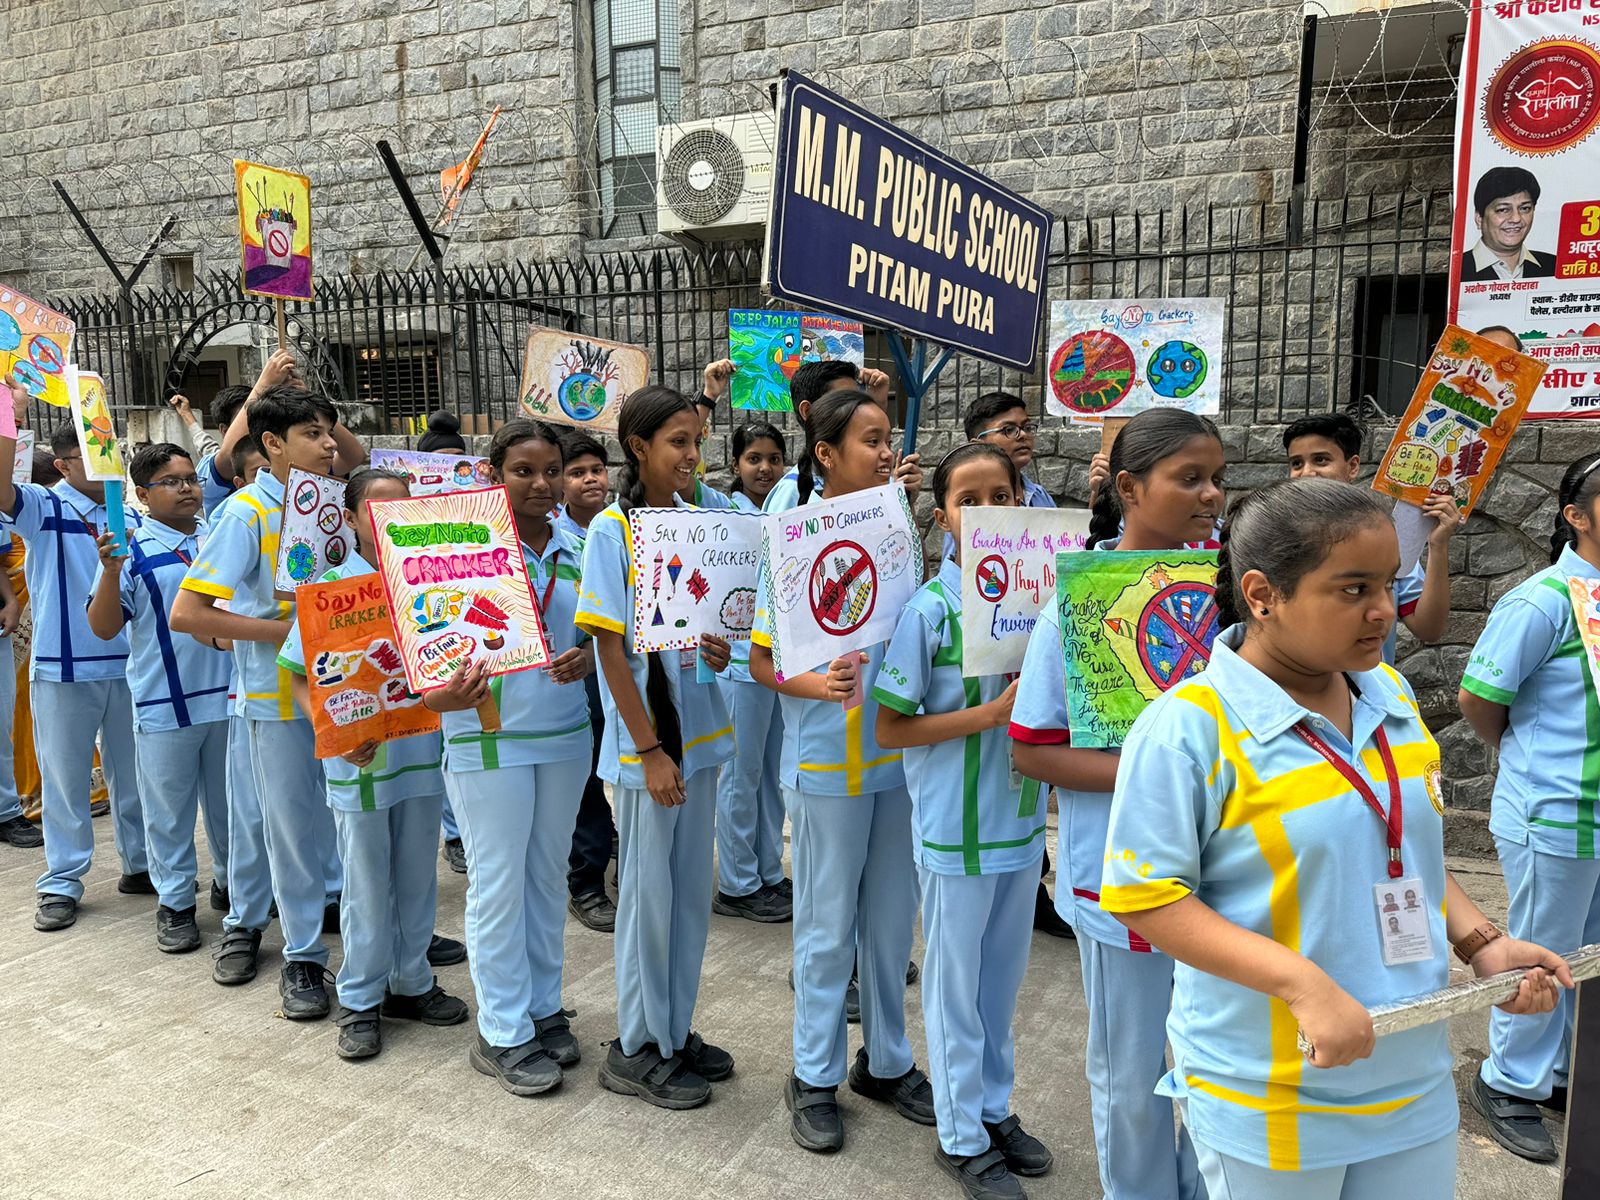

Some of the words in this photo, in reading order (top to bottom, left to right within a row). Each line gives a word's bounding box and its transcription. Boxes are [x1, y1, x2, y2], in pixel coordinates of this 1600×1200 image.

[1582, 14, 1600, 26] NS
[794, 105, 864, 221] M.M.
[873, 145, 962, 260] PUBLIC
[965, 192, 1040, 294] SCHOOL
[1562, 260, 1588, 276] रात्रि
[848, 243, 931, 313] PITAM
[937, 278, 995, 335] PURA
[1464, 282, 1487, 294] अशोक
[1488, 281, 1510, 292] गोयल
[1511, 280, 1539, 291] देवराहा
[1489, 293, 1511, 301] अध्यक्ष
[1101, 309, 1121, 329] Say
[1144, 311, 1154, 322] to
[1552, 305, 1583, 315] हल्दीराम
[1584, 303, 1592, 313] के
[733, 312, 761, 326] DEEP
[762, 314, 799, 329] JALAO
[1529, 347, 1552, 357] आप
[1554, 343, 1580, 356] सभी
[1431, 352, 1464, 379] Say
[1466, 357, 1493, 383] No
[1496, 381, 1517, 407] to
[1542, 368, 1587, 389] सीए
[386, 522, 430, 547] Say
[434, 522, 462, 545] No
[464, 521, 490, 545] to
[652, 523, 678, 543] SAY
[687, 525, 706, 544] NO
[712, 523, 729, 542] TO
[786, 522, 803, 542] SAY
[805, 517, 819, 536] NO
[821, 515, 834, 533] TO
[837, 506, 884, 529] CRACKERS
[1075, 532, 1086, 547] Us
[402, 547, 514, 586] CRACKER
[702, 549, 757, 567] CRACKERS
[1011, 558, 1040, 604] They
[1043, 563, 1055, 588] Ar
[315, 589, 356, 616] Say
[358, 583, 382, 600] No
[1065, 640, 1097, 664] No
[1089, 660, 1116, 674] use
[1070, 675, 1099, 700] They
[350, 705, 374, 722] AIR
[1078, 700, 1107, 718] just
